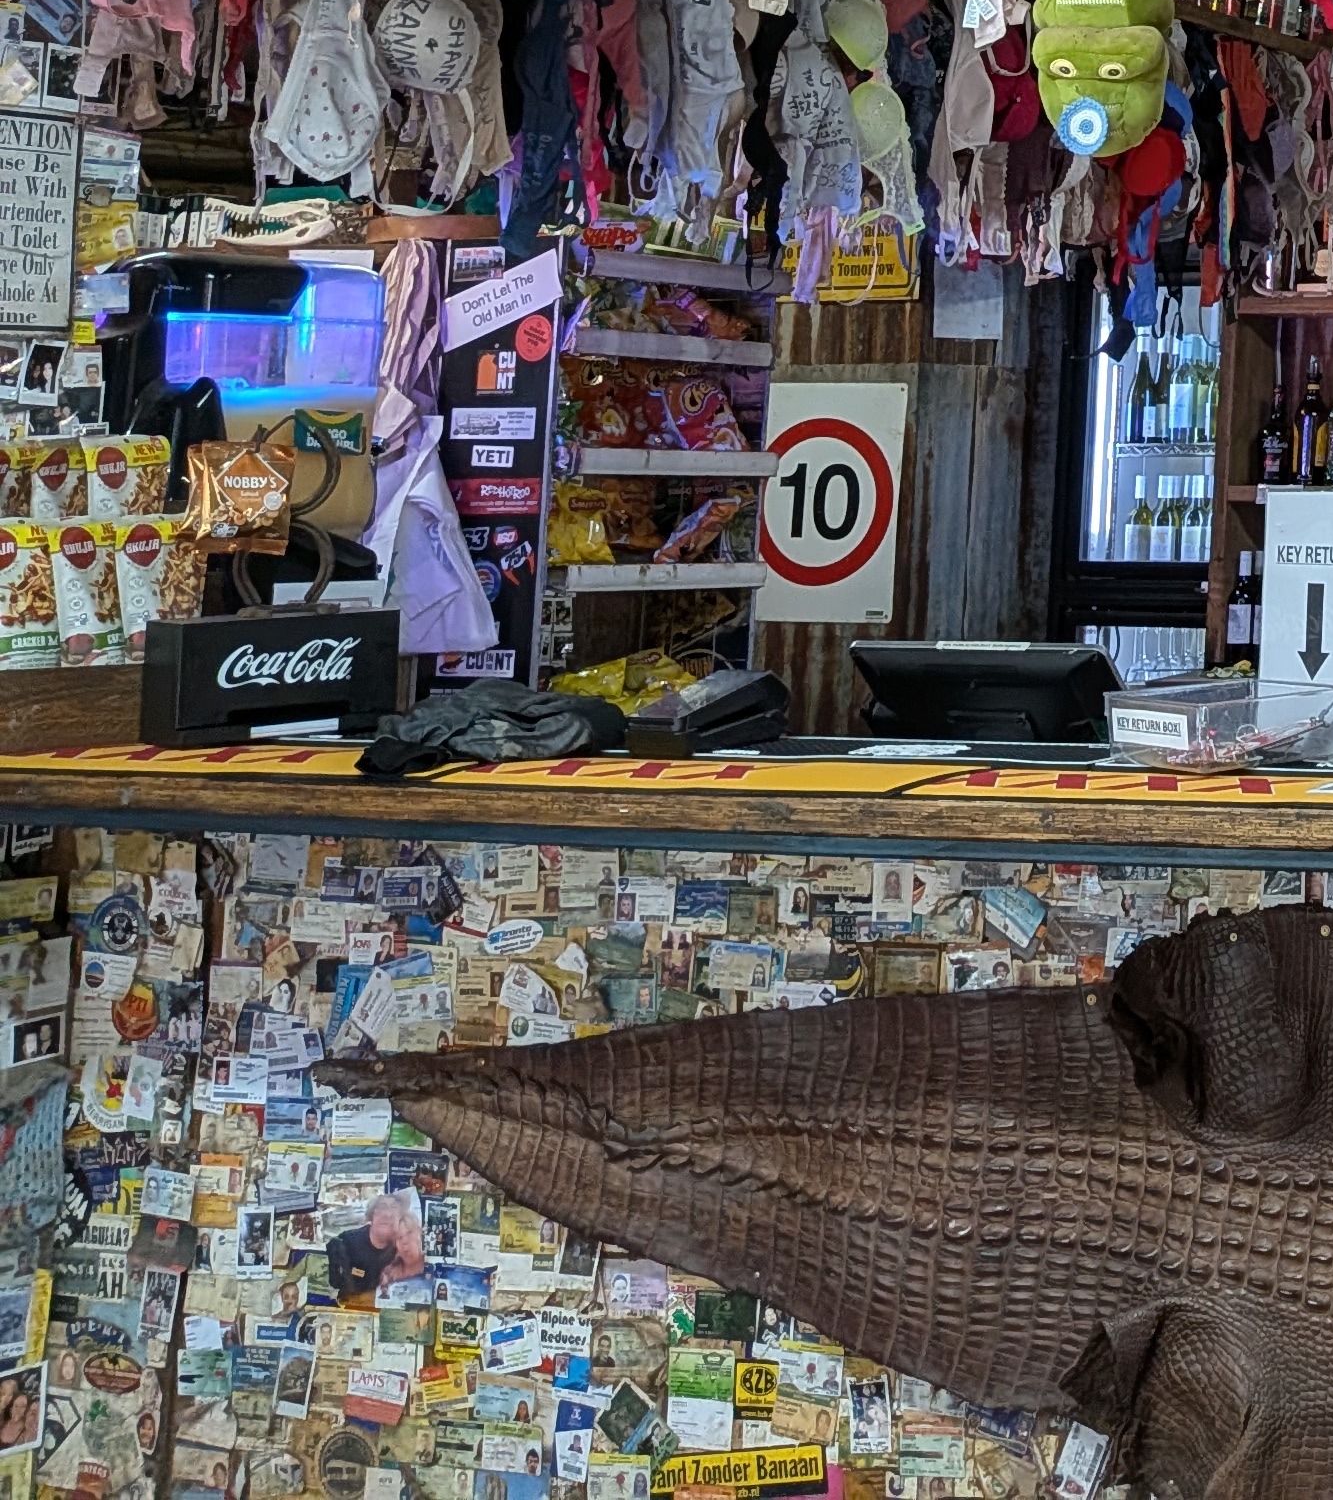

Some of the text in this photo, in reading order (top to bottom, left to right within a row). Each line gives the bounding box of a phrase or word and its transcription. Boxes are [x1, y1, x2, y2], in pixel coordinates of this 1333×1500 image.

[462, 274, 534, 314] Don't Let The
[473, 292, 532, 327] Old Man In
[475, 449, 511, 464] YETI
[223, 474, 278, 489] NOBBY'S
[779, 461, 861, 541] 10
[1277, 546, 1302, 564] KEY
[217, 637, 362, 689] Coca-Cola
[692, 1459, 750, 1486] Zonder
[756, 1454, 819, 1480] Banaan
